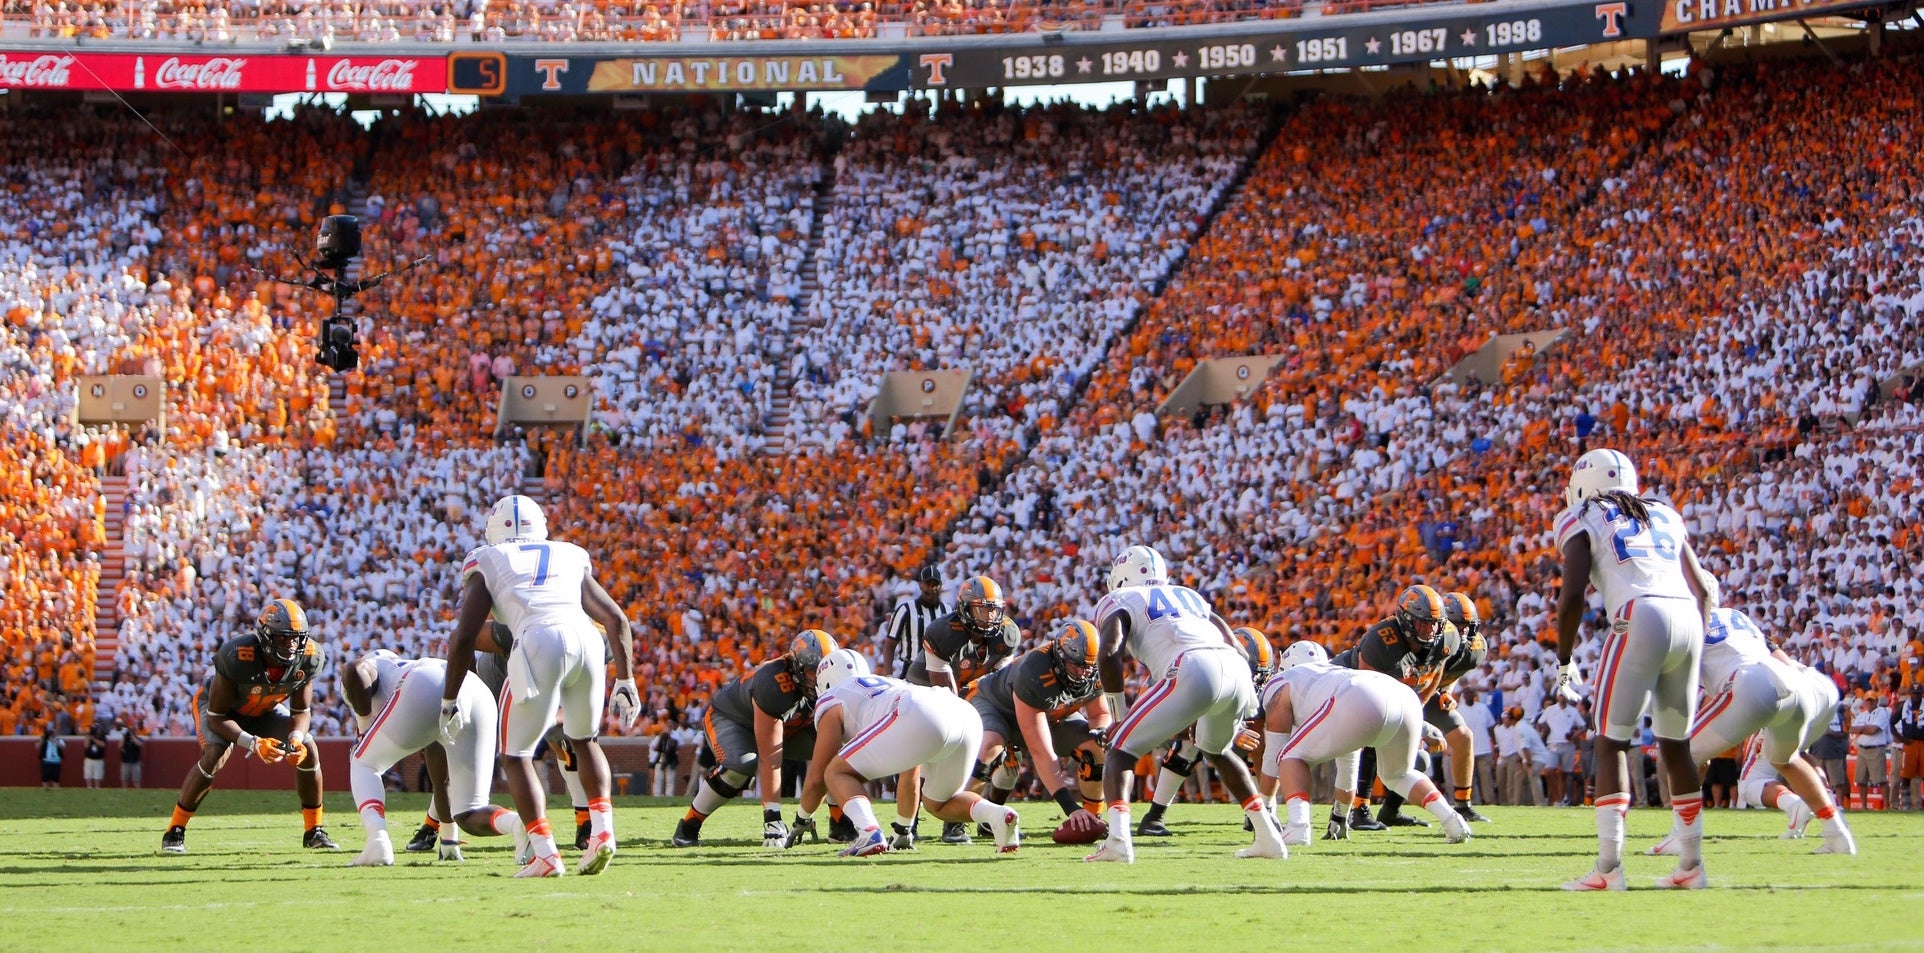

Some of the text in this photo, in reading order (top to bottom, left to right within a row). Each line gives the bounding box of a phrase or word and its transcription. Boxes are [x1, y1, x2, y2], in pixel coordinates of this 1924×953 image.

[1595, 2, 1627, 37] T
[1002, 19, 1542, 79] 1938 1940 1950 1951 1967 1998
[535, 58, 568, 90] T
[631, 60, 843, 86] NATIONAL
[919, 53, 953, 85] T
[1602, 504, 1677, 564] 26
[518, 543, 551, 586] 7
[1146, 587, 1207, 624] 40
[1377, 625, 1400, 646] 63
[774, 670, 797, 694] 66
